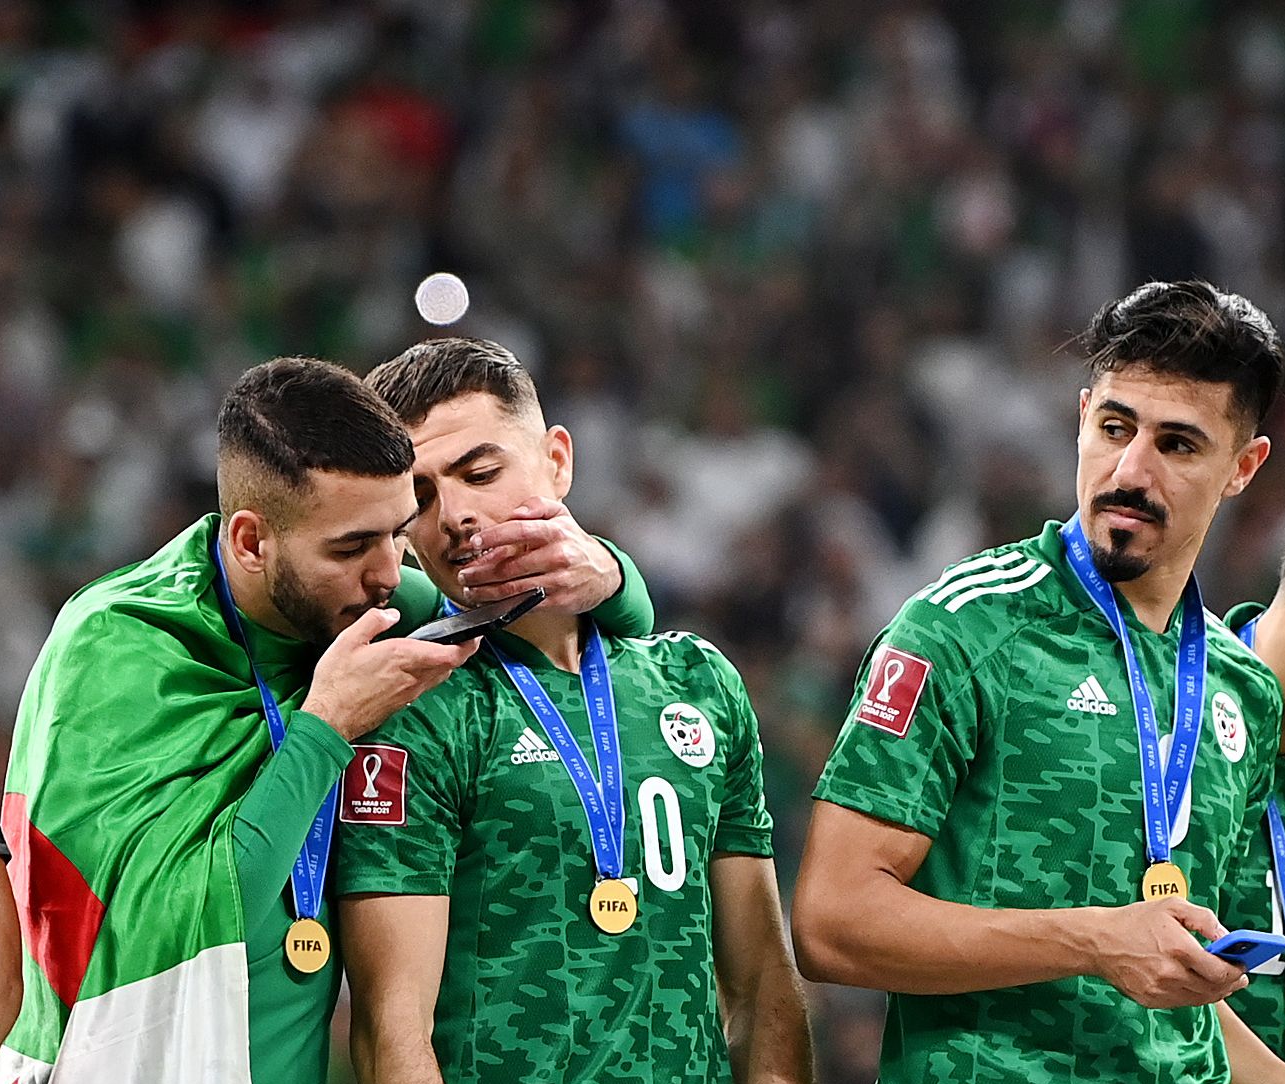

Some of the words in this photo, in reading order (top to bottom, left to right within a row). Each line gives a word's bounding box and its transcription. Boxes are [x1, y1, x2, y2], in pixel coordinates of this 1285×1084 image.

[1086, 571, 1104, 593] FIFA
[514, 666, 532, 685] FIFA
[589, 664, 601, 686] FIFA
[533, 696, 551, 716] FIFA
[595, 698, 606, 719] FIFA
[1067, 698, 1118, 715] adidas
[1142, 707, 1152, 732] FIFA
[1184, 708, 1194, 732] FIFA
[552, 726, 569, 748] FIFA
[600, 731, 612, 754] FIFA
[510, 750, 560, 765] adidas
[1147, 745, 1156, 770] FIFA
[1176, 743, 1188, 769] FIFA
[570, 758, 587, 780] FIFA
[605, 765, 615, 789] FIFA
[587, 792, 601, 815] FIFA
[1151, 782, 1160, 807] FIFA
[1167, 780, 1179, 805] FIFA
[596, 828, 609, 852] FIFA
[1155, 821, 1166, 845] FIFA
[1150, 883, 1179, 897] FIFA
[598, 900, 629, 913] FIFA
[293, 939, 323, 952] FIFA
